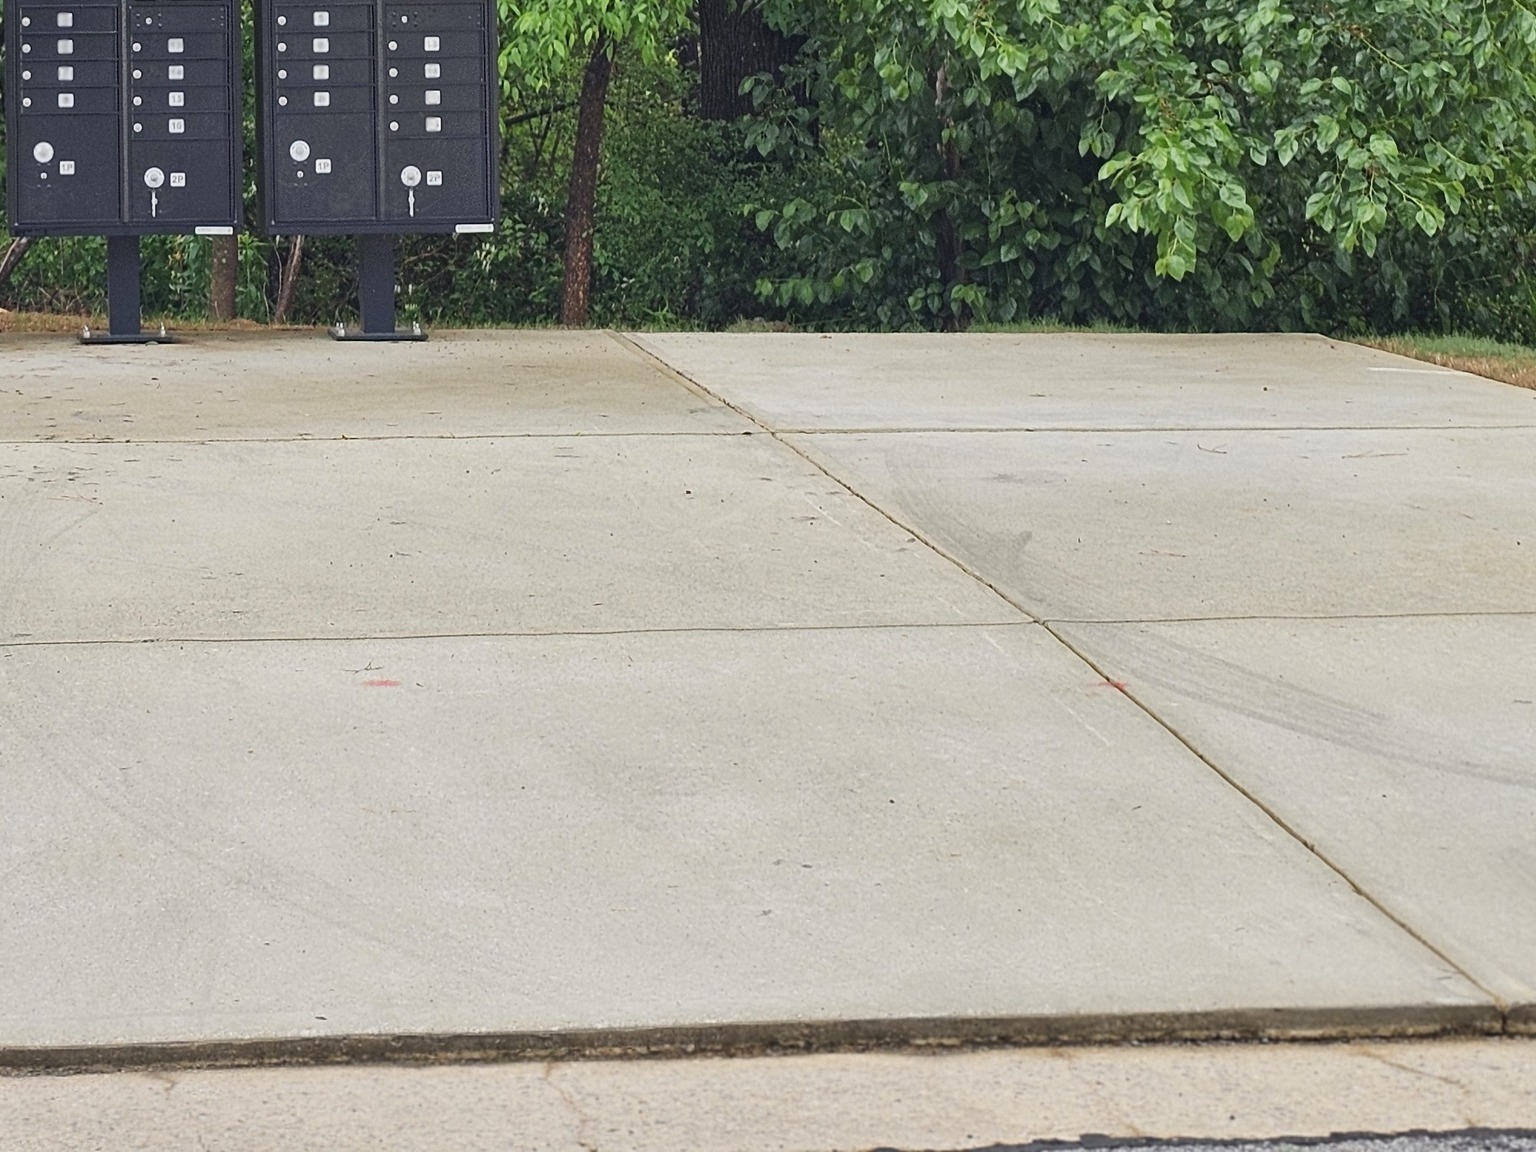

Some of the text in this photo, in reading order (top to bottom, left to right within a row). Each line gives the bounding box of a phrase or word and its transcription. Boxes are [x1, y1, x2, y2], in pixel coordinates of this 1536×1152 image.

[62, 163, 73, 172] 1P
[318, 162, 329, 171] 1P
[172, 175, 184, 184] 2P
[429, 174, 440, 183] 2P
